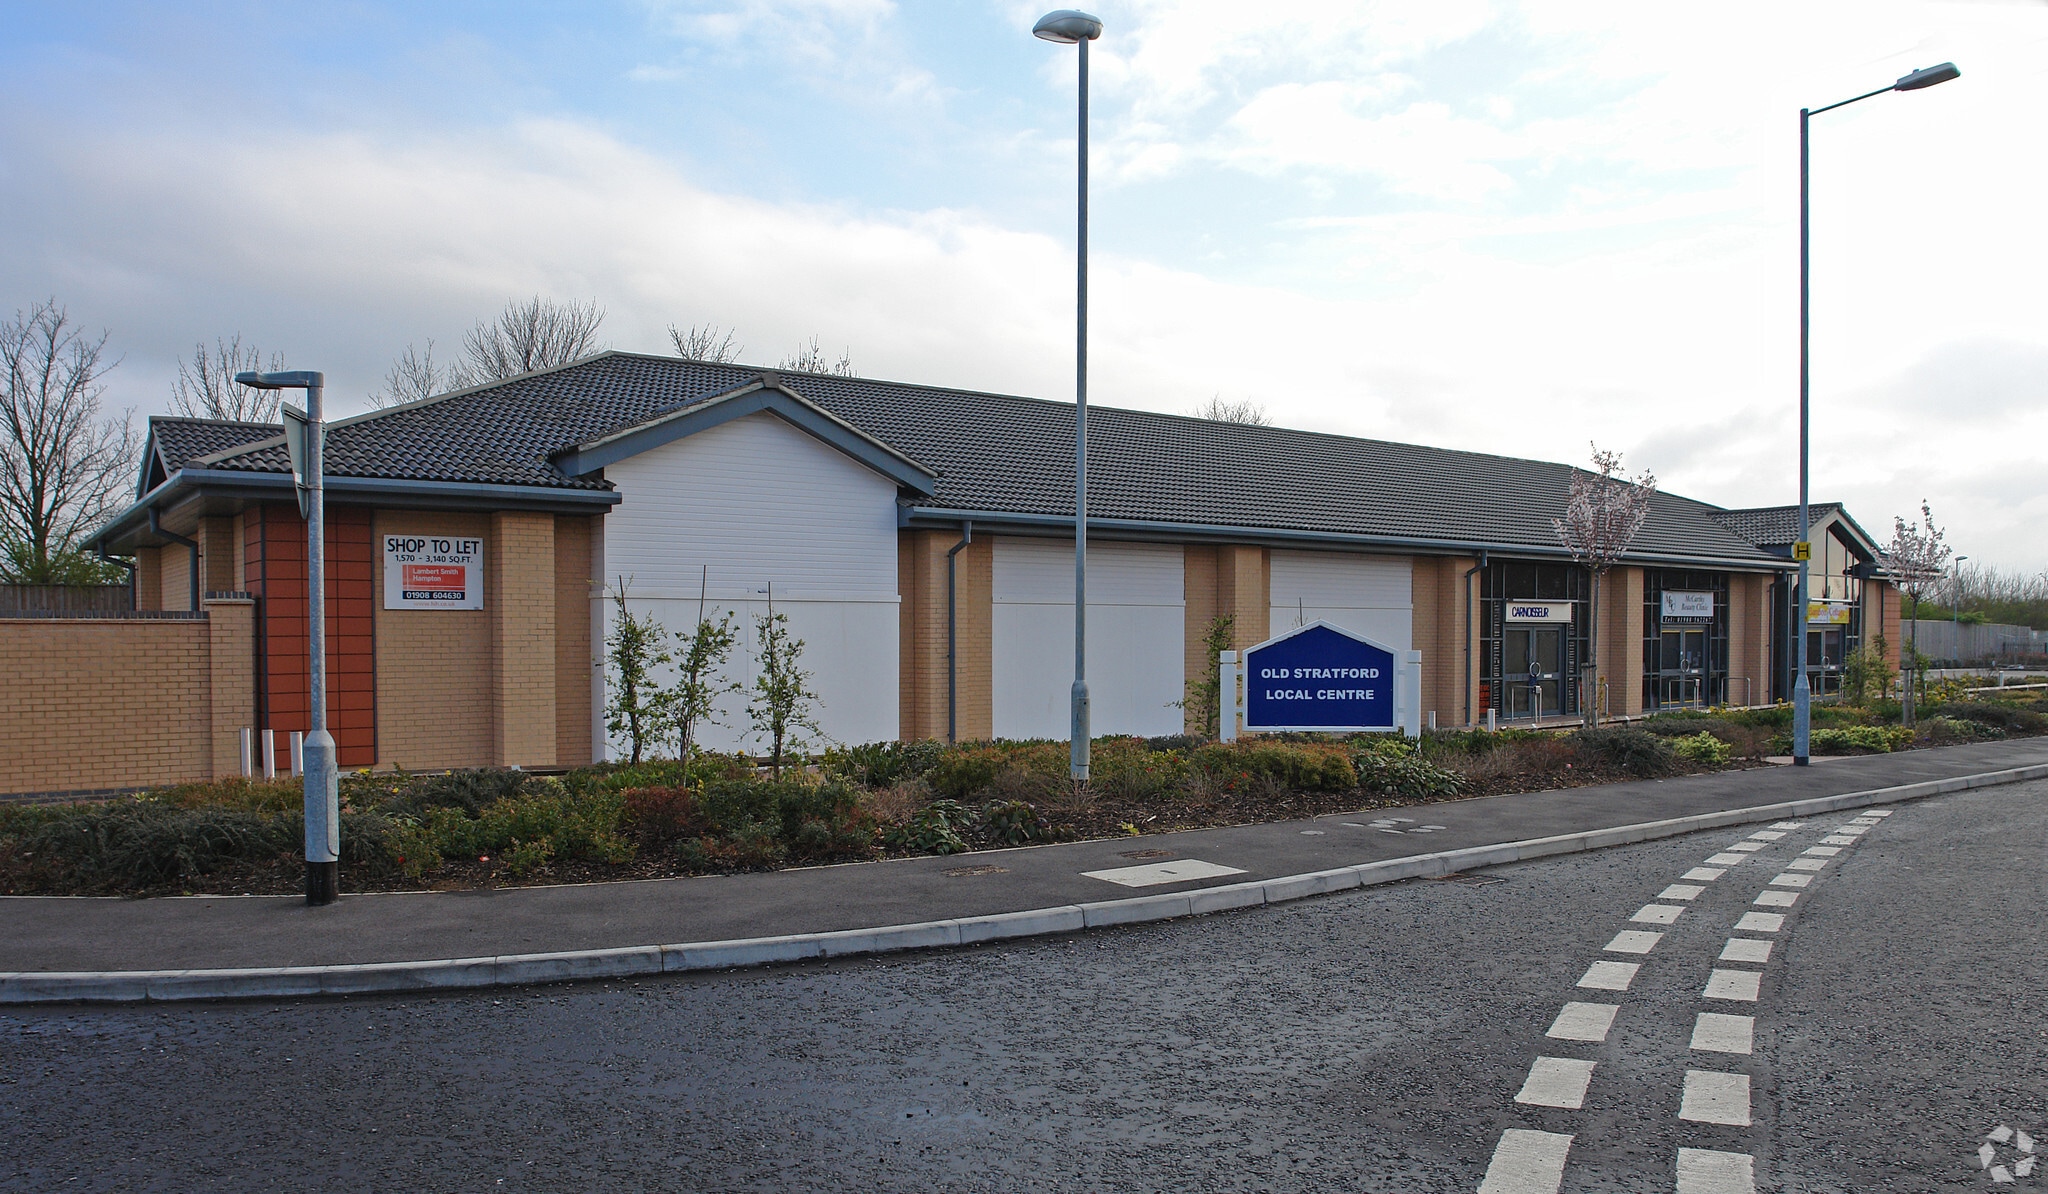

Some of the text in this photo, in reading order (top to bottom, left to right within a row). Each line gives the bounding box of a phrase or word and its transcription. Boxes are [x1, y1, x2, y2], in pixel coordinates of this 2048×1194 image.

[388, 538, 479, 554] SHOP TO LET
[1797, 544, 1809, 558] H
[395, 554, 415, 562] 1,570
[426, 555, 446, 563] 3,140
[406, 591, 430, 599] 01908
[1261, 668, 1379, 679] OLD STRATFORD
[1266, 689, 1375, 700] LOCAL CENTRE
